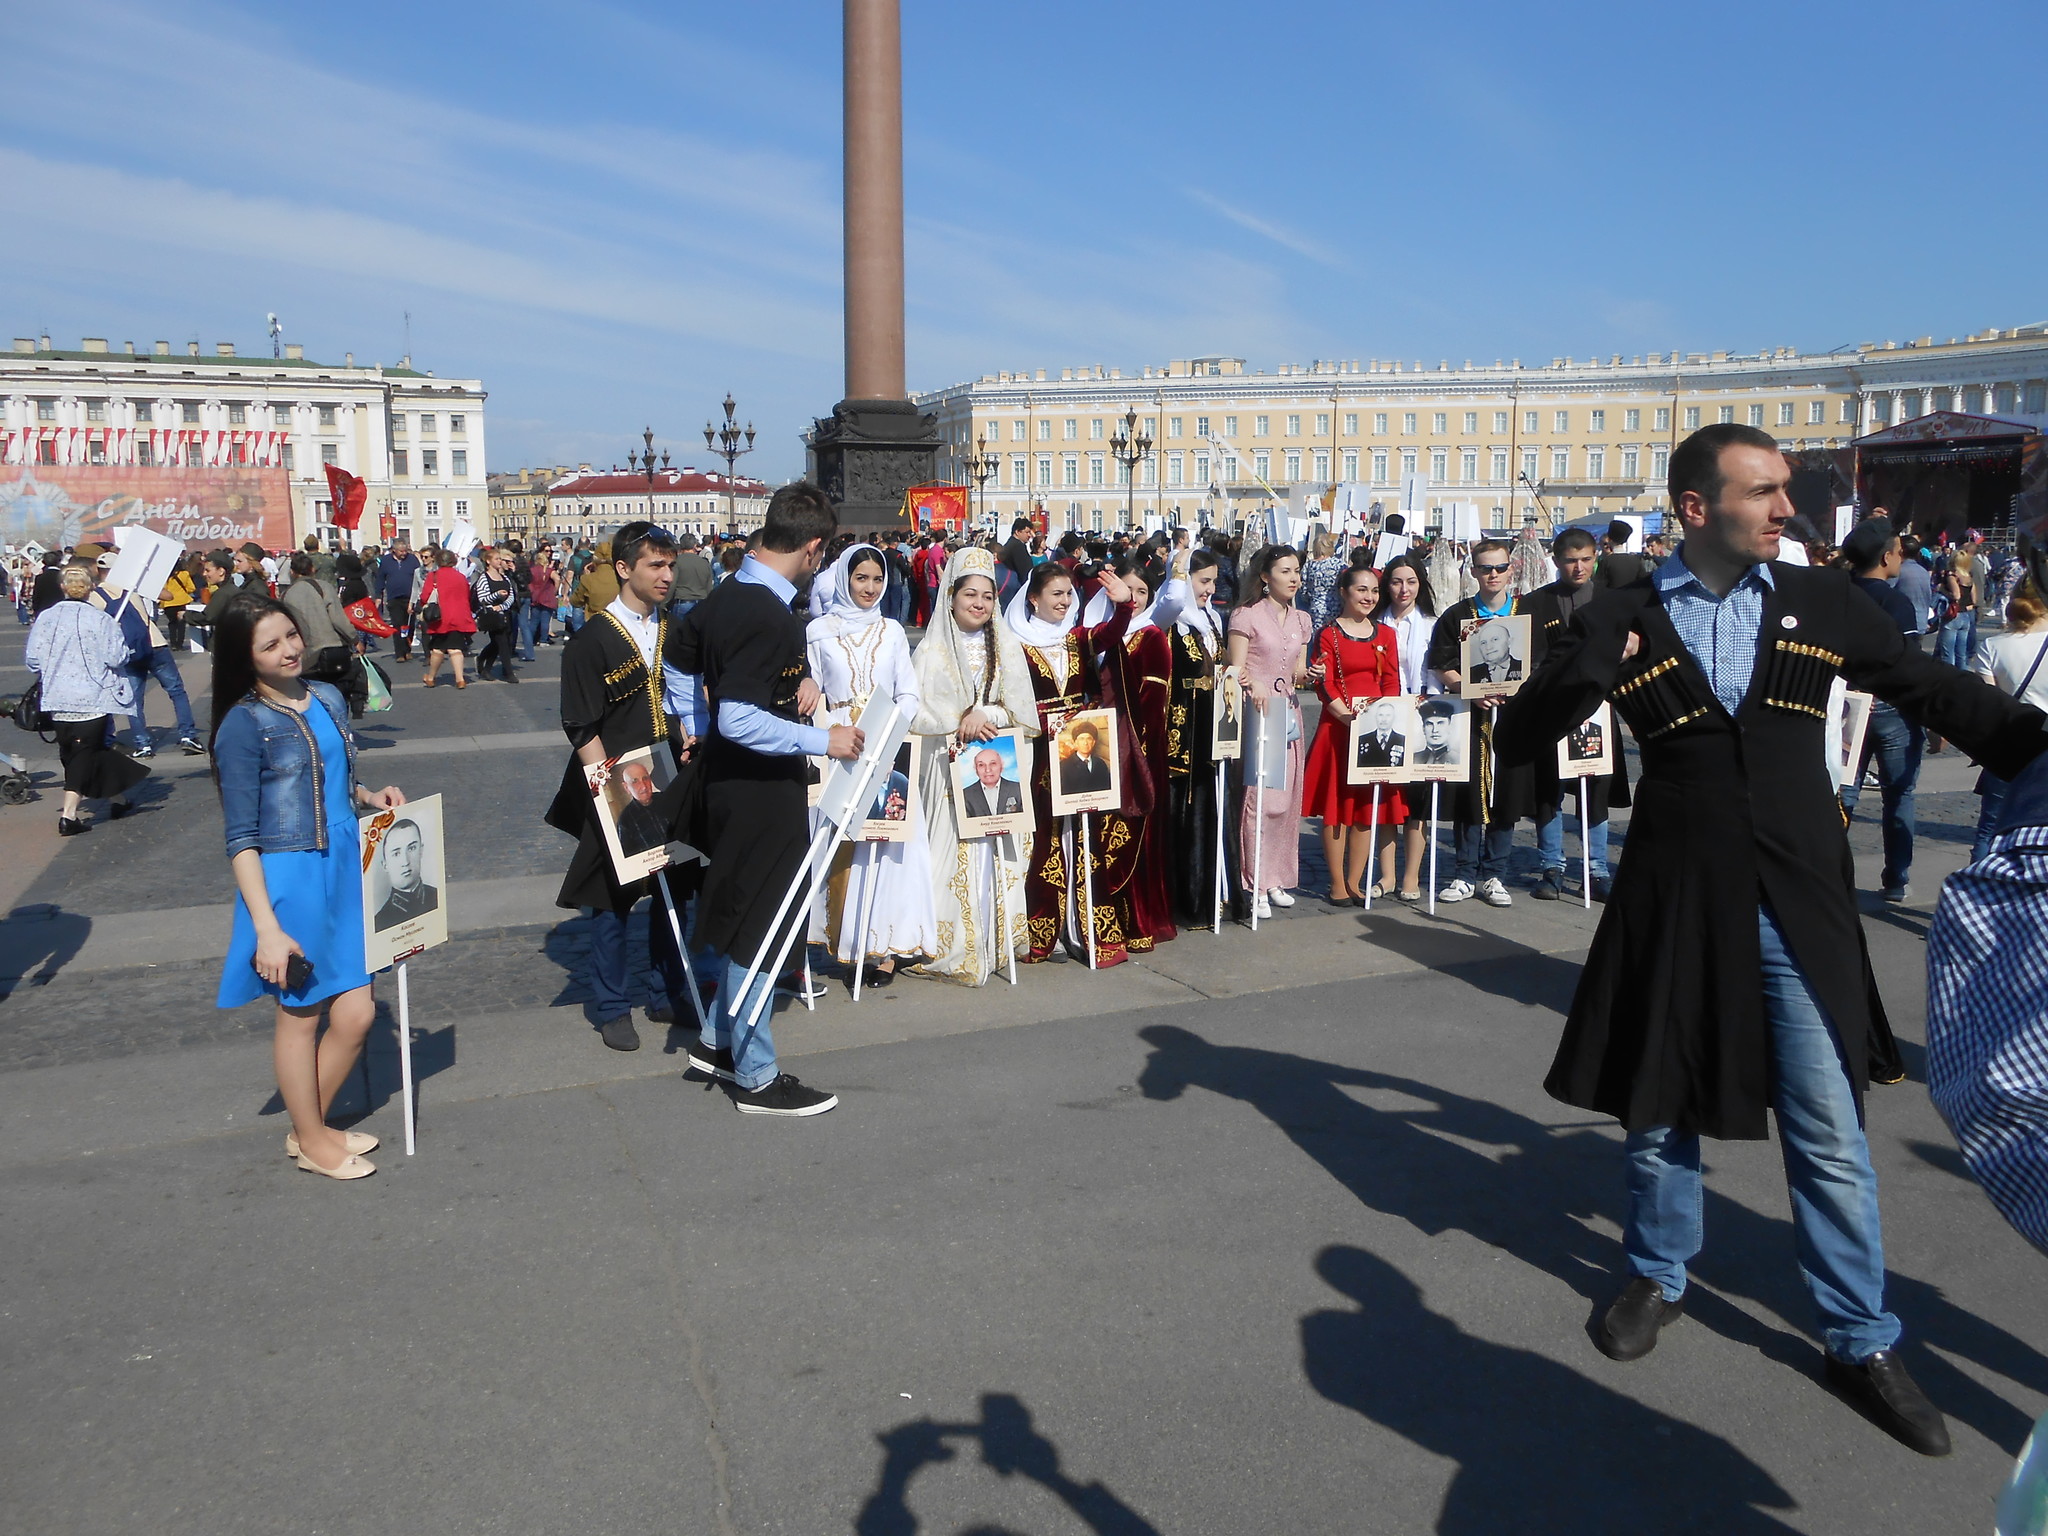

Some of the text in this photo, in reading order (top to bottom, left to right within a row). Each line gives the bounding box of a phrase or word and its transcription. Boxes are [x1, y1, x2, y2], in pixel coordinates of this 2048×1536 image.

[97, 497, 200, 524] С Днём
[167, 516, 264, 540] Победы!
